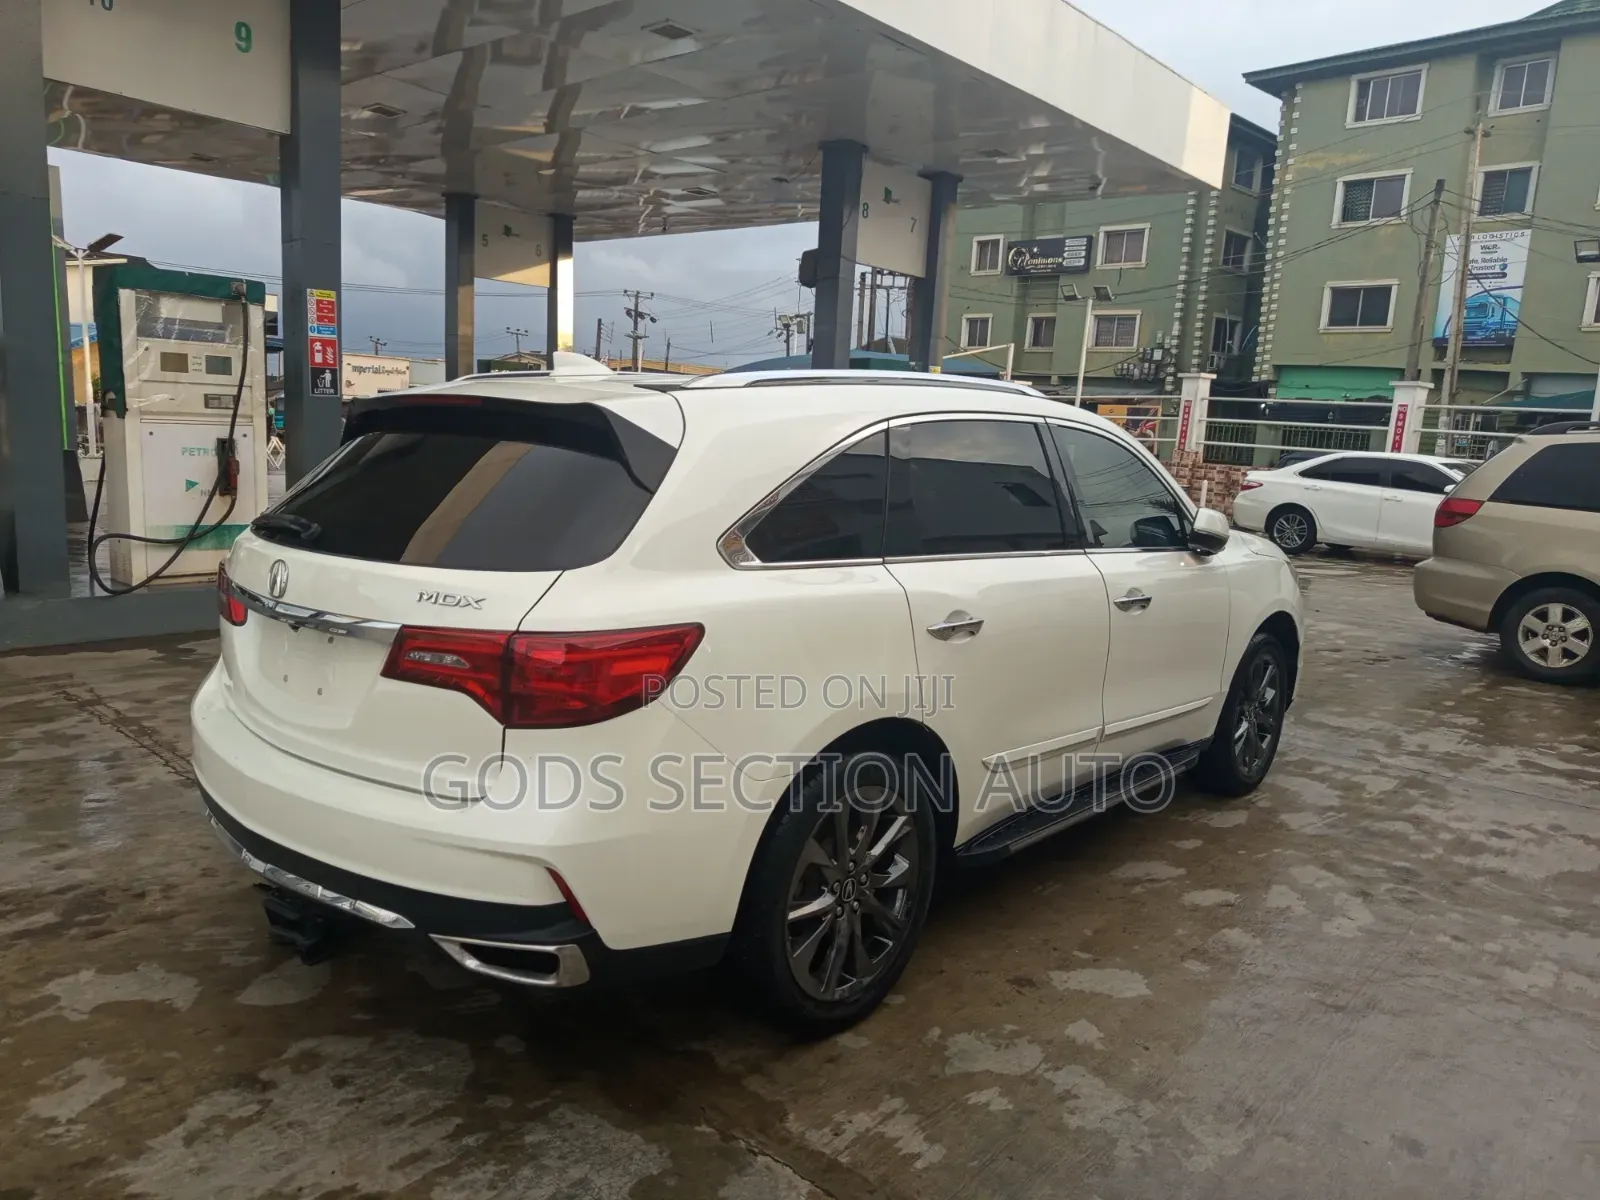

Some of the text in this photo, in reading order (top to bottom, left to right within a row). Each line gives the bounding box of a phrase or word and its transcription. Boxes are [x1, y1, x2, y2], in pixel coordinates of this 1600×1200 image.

[234, 21, 252, 53] 9
[862, 202, 869, 219] 8
[910, 216, 917, 233] 7
[481, 233, 489, 248] 5
[1477, 231, 1525, 240] LOGISTICS
[1481, 256, 1508, 264] Reliable
[1393, 413, 1404, 453] SMOKI
[416, 590, 486, 610] MDX
